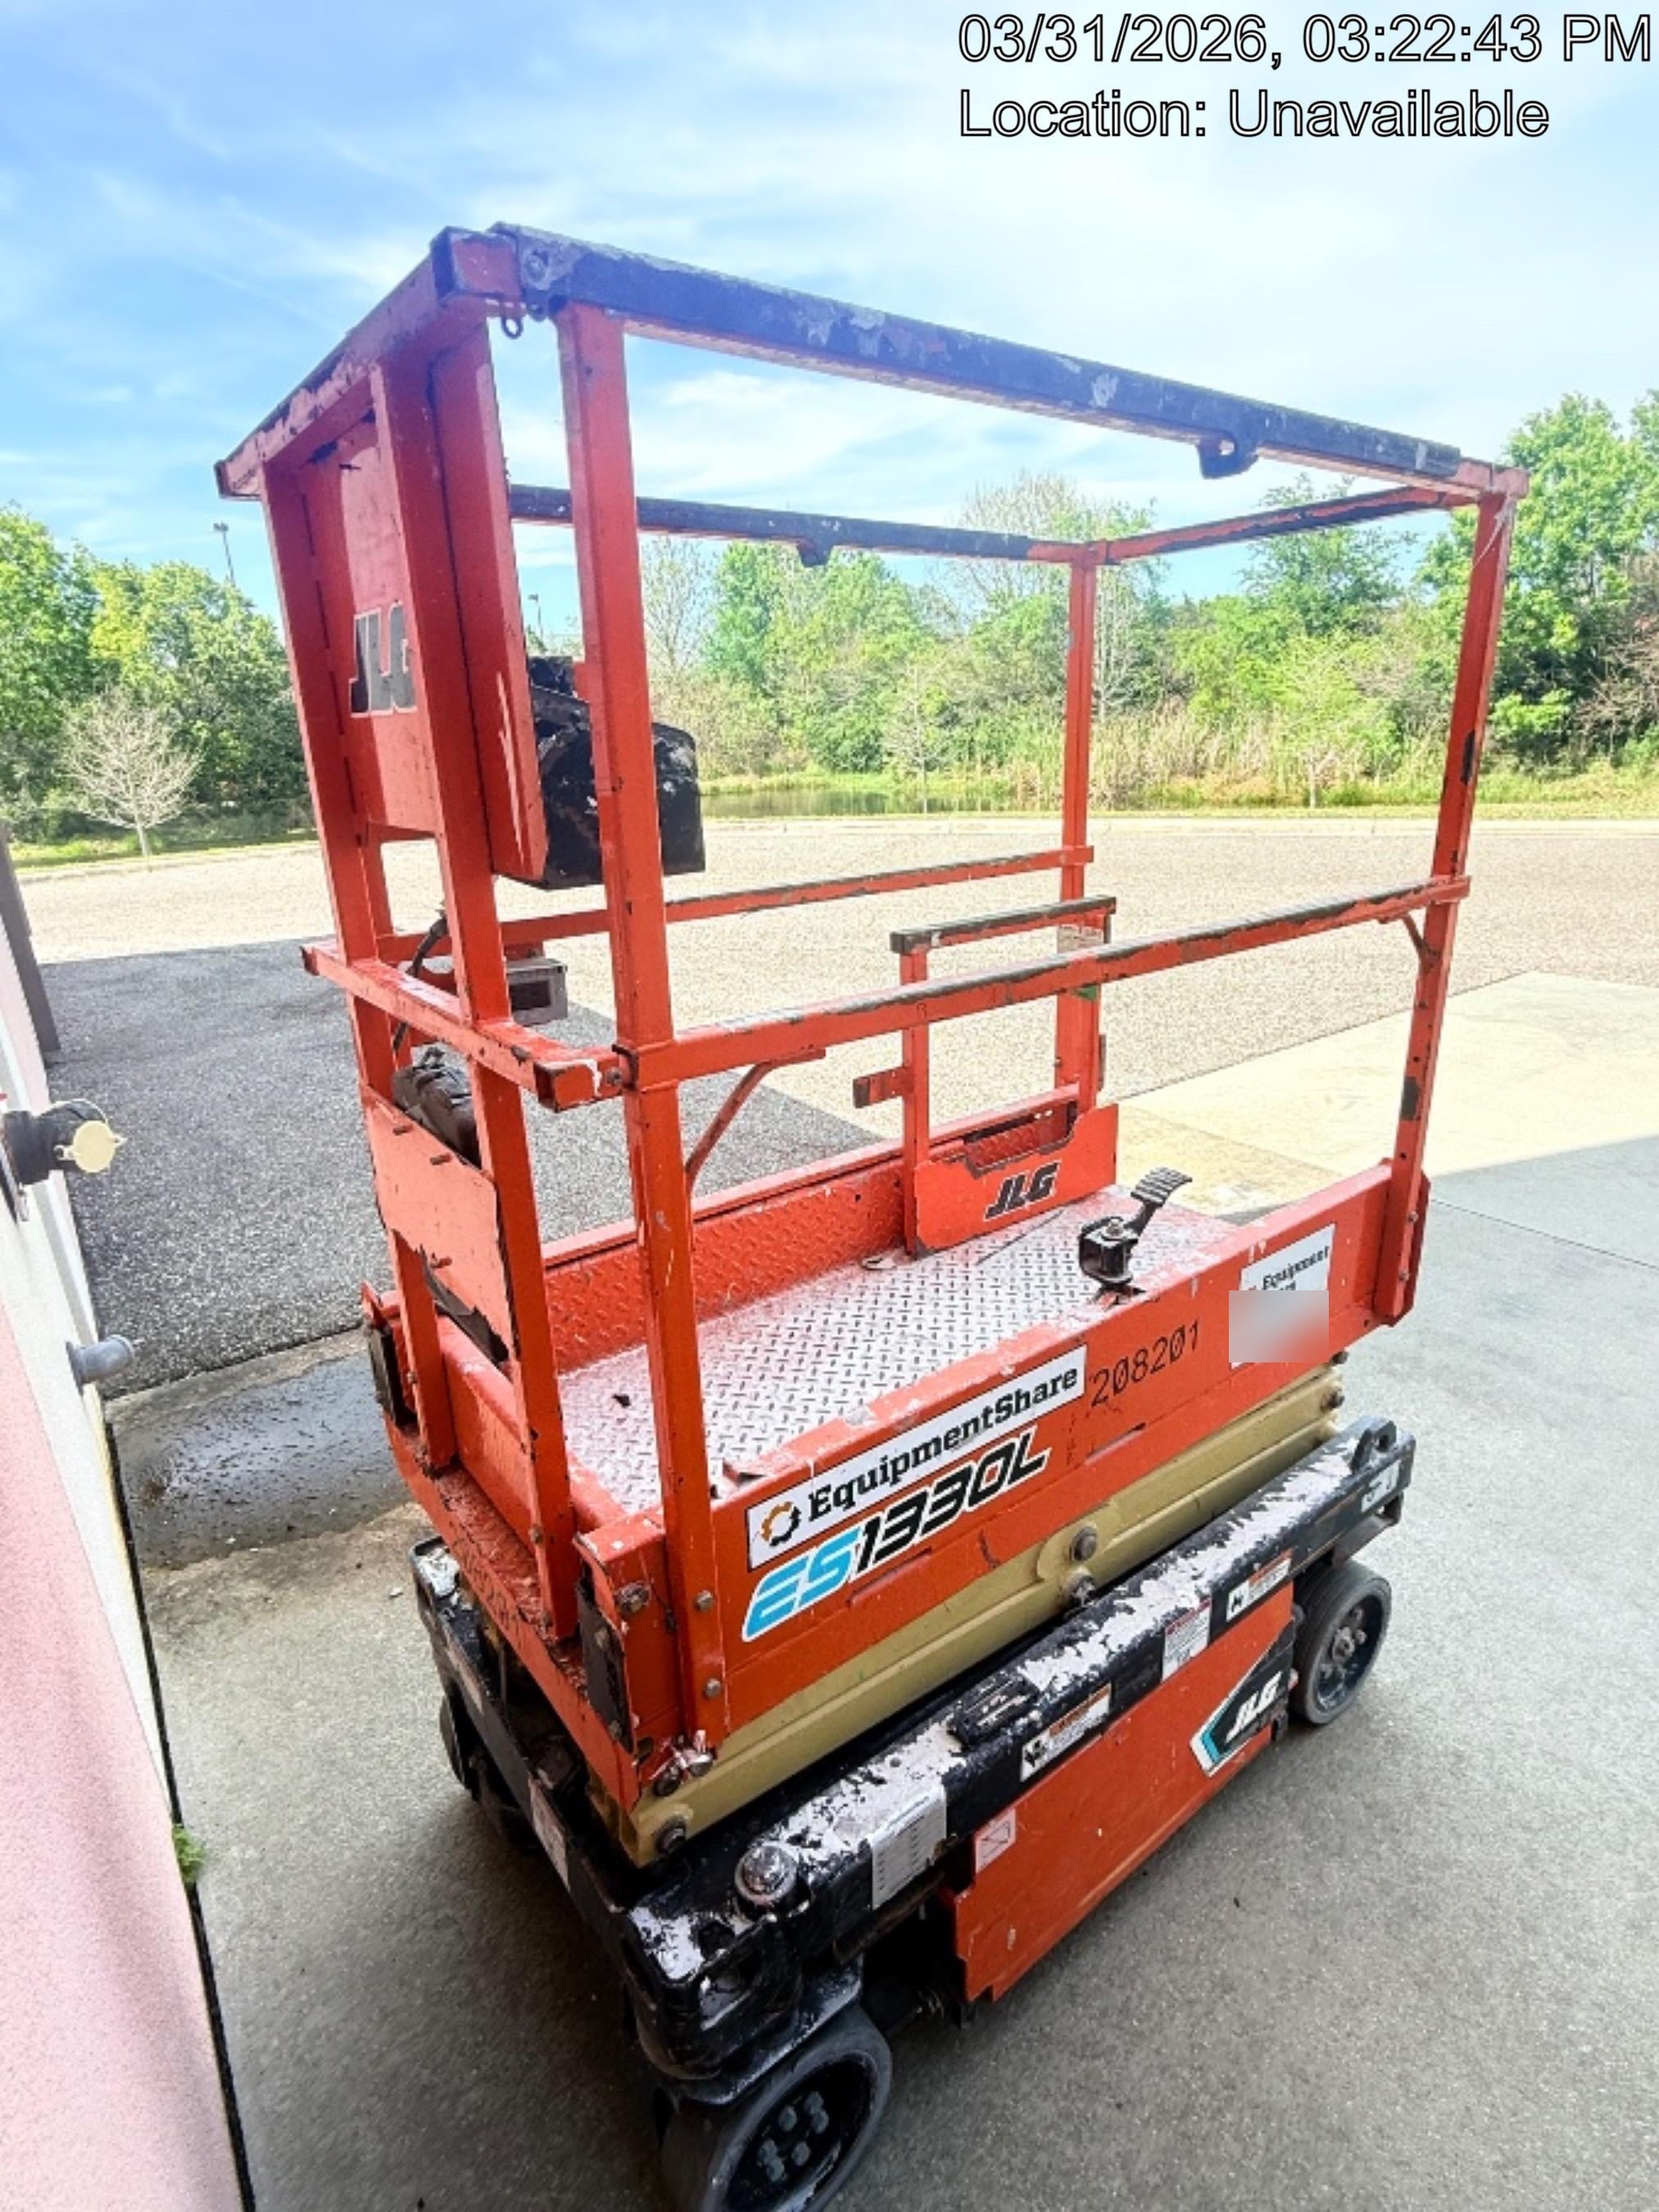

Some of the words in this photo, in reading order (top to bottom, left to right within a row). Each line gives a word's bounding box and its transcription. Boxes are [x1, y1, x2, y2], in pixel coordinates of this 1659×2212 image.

[983, 1160, 1061, 1222] JLG
[1090, 1318, 1199, 1407] 208201
[808, 1366, 1078, 1522] EquipmentShare
[742, 1426, 1052, 1642] ES1330L
